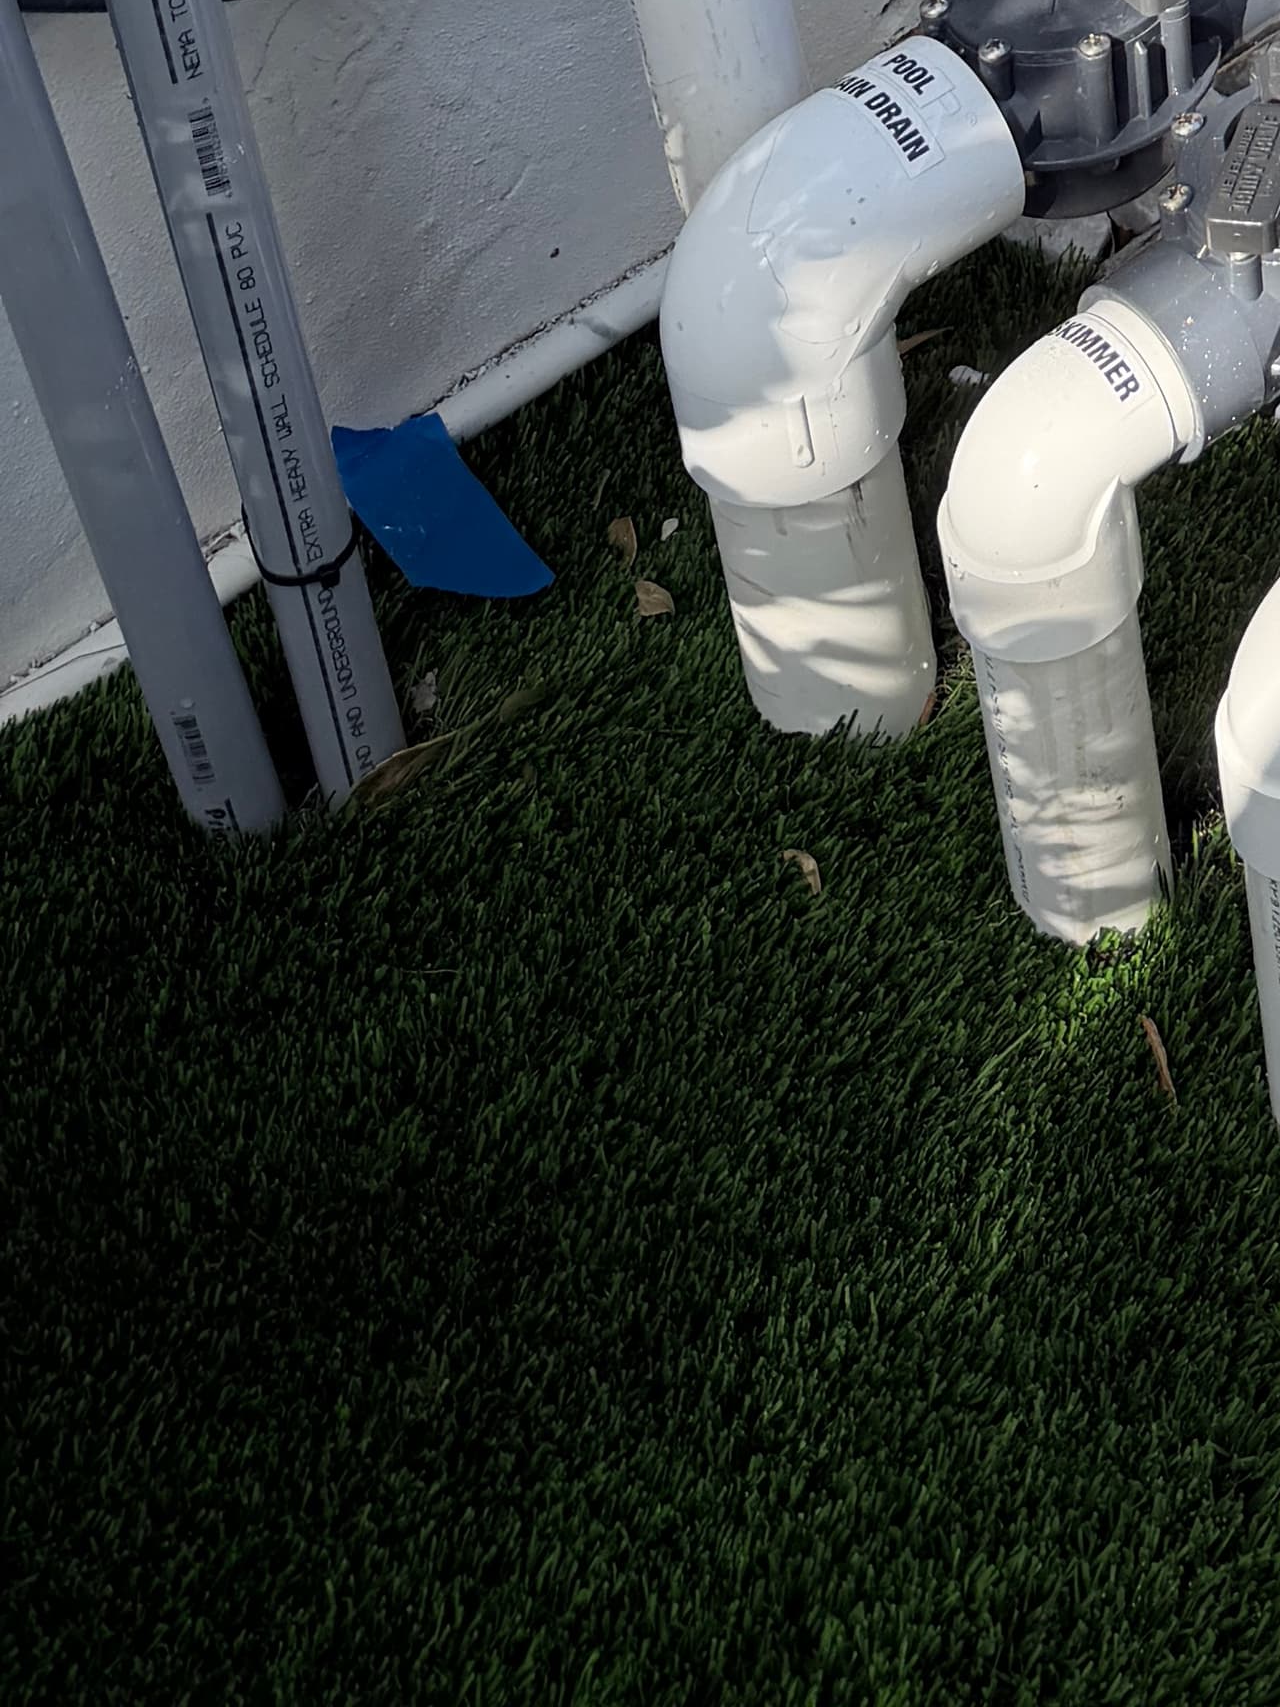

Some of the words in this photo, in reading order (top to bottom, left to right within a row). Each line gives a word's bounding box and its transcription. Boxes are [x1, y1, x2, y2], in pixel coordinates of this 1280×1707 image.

[178, 27, 203, 82] NEMA
[882, 53, 936, 96] POOL
[834, 75, 877, 99] AIN
[863, 91, 931, 163] DRAIN
[225, 221, 249, 261] PVC
[236, 265, 257, 291] 80
[244, 297, 281, 389] SCHEDULE
[270, 393, 295, 445] WALL
[281, 448, 309, 504] HEAVY
[299, 506, 325, 565] EXTRA
[315, 587, 358, 701] UNDERGROUND
[346, 705, 367, 736] AND
